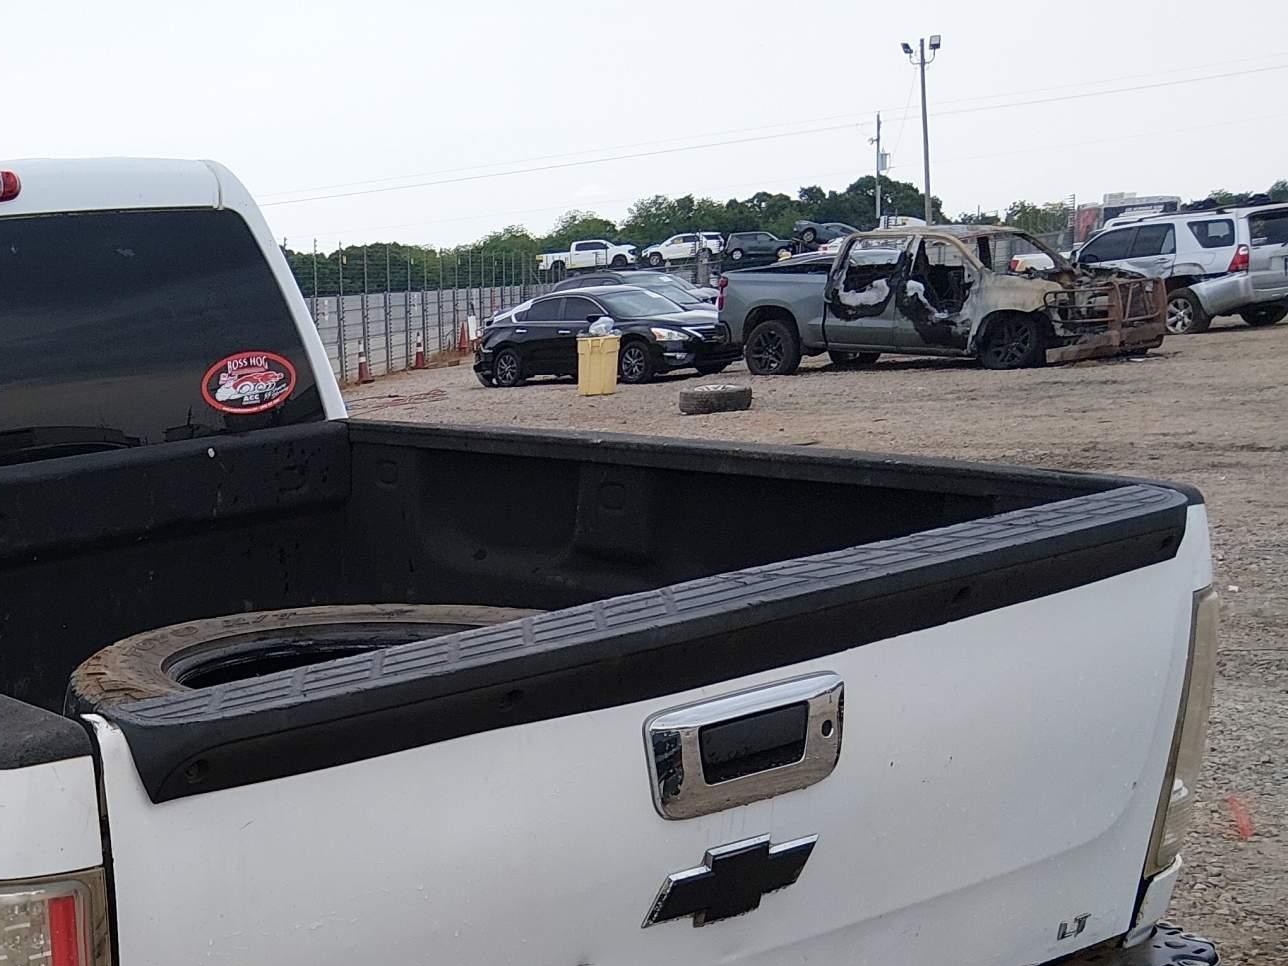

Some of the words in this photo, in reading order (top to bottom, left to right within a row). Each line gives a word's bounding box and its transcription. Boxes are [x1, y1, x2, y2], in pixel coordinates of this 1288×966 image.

[227, 358, 248, 374] BOSS
[250, 356, 269, 369] HOG
[243, 394, 260, 402] ACC
[1057, 912, 1092, 941] LT
